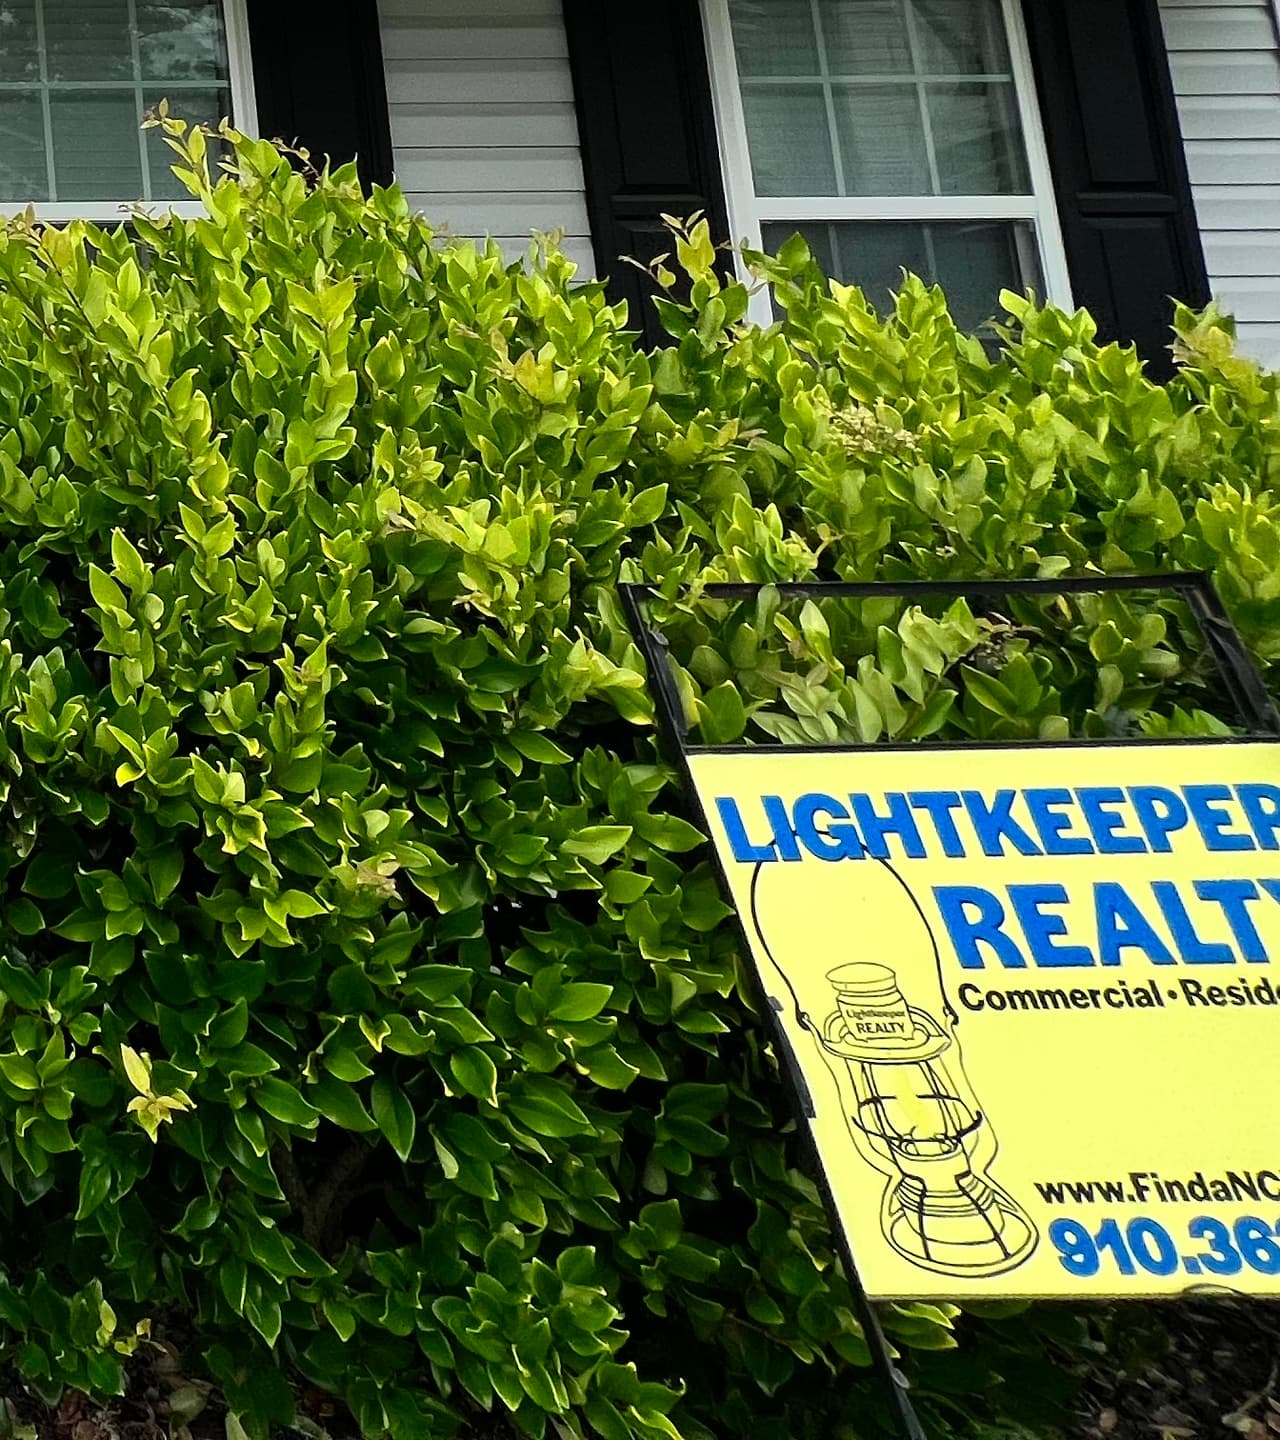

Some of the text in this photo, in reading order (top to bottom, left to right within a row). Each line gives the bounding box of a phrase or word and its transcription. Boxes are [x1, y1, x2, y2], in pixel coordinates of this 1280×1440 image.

[714, 783, 1280, 863] LIGHTKEEPER
[1178, 976, 1280, 1008] Resid
[855, 1022, 905, 1034] REALTY
[1034, 1170, 1280, 1204] www.FindaNC
[1048, 1215, 1280, 1278] 910.36
